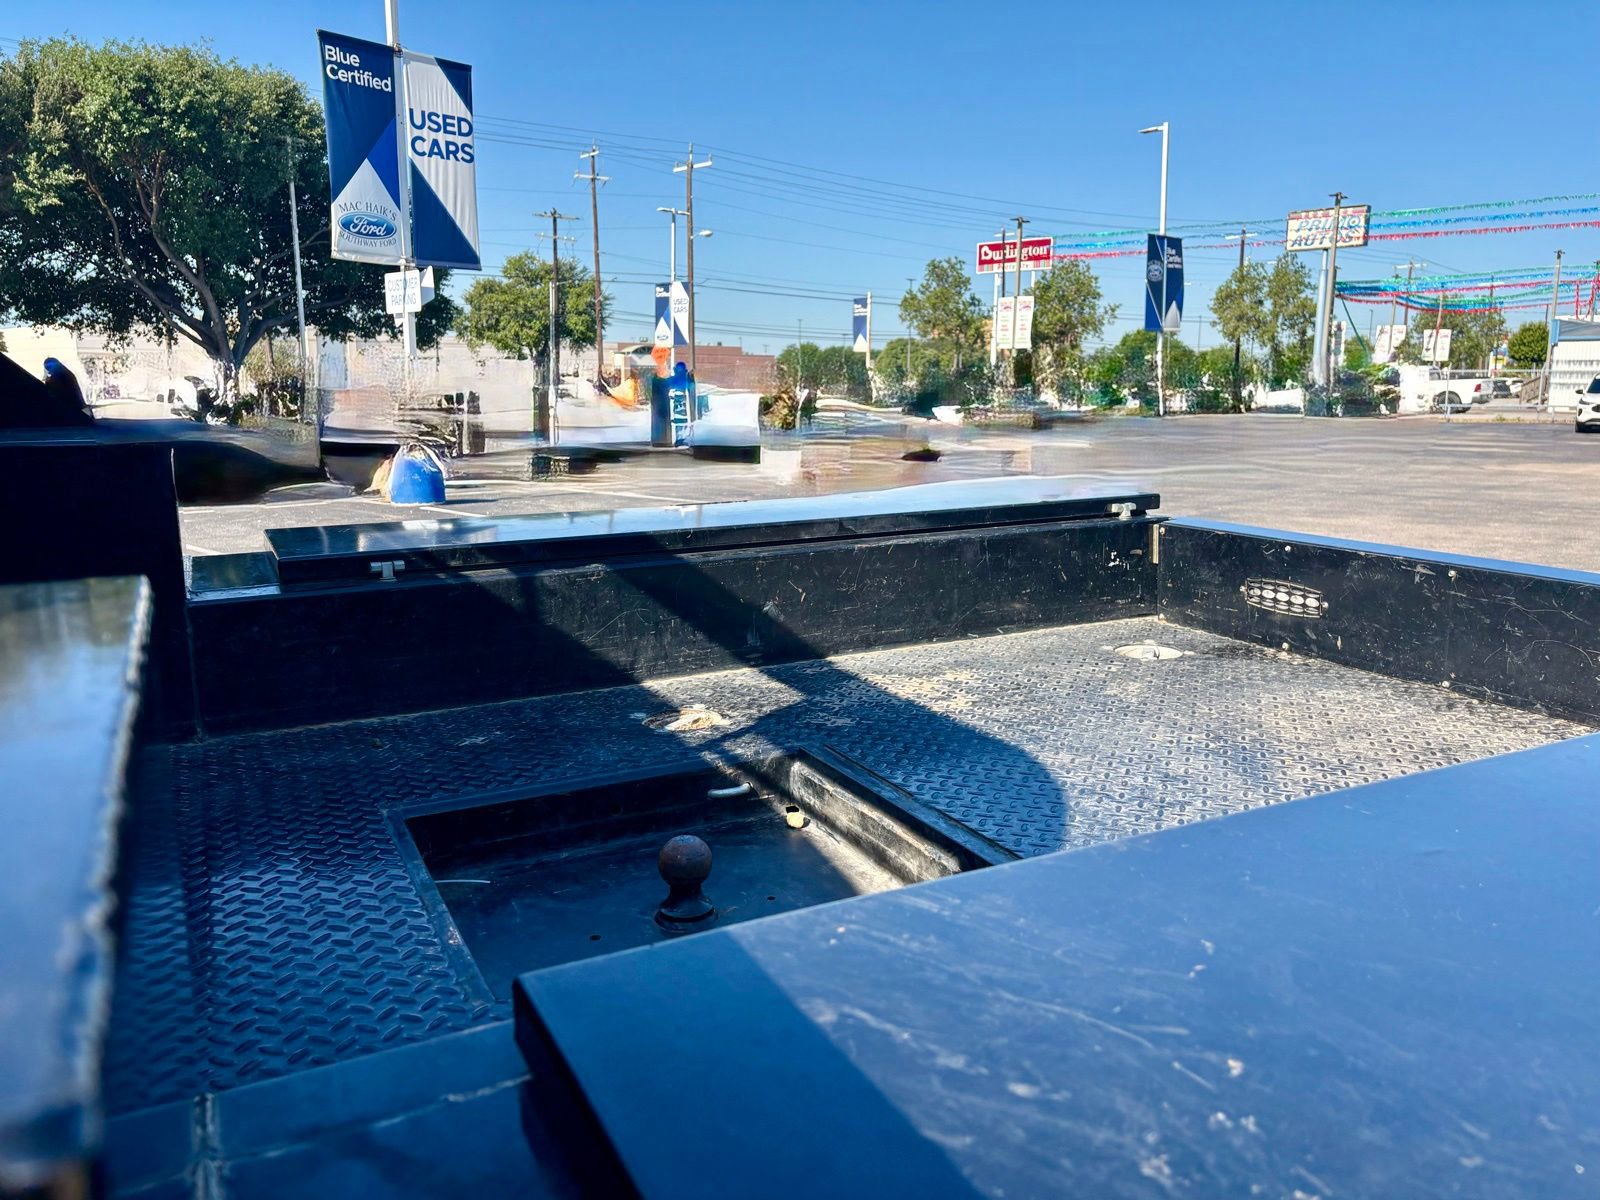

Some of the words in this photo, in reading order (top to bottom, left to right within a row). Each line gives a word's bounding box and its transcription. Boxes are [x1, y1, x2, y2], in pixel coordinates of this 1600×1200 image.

[324, 44, 360, 67] Blue
[325, 64, 392, 92] Certified
[409, 107, 474, 138] USED
[410, 135, 475, 164] CARS
[338, 201, 362, 213] MAC
[365, 201, 397, 221] HAIK'S
[350, 214, 388, 236] Ford
[339, 230, 378, 248] SOUTHWAY
[379, 237, 397, 248] FORD
[981, 244, 1048, 260] Buligton
[387, 276, 418, 292] CUSTMER
[390, 292, 417, 306] PARNG
